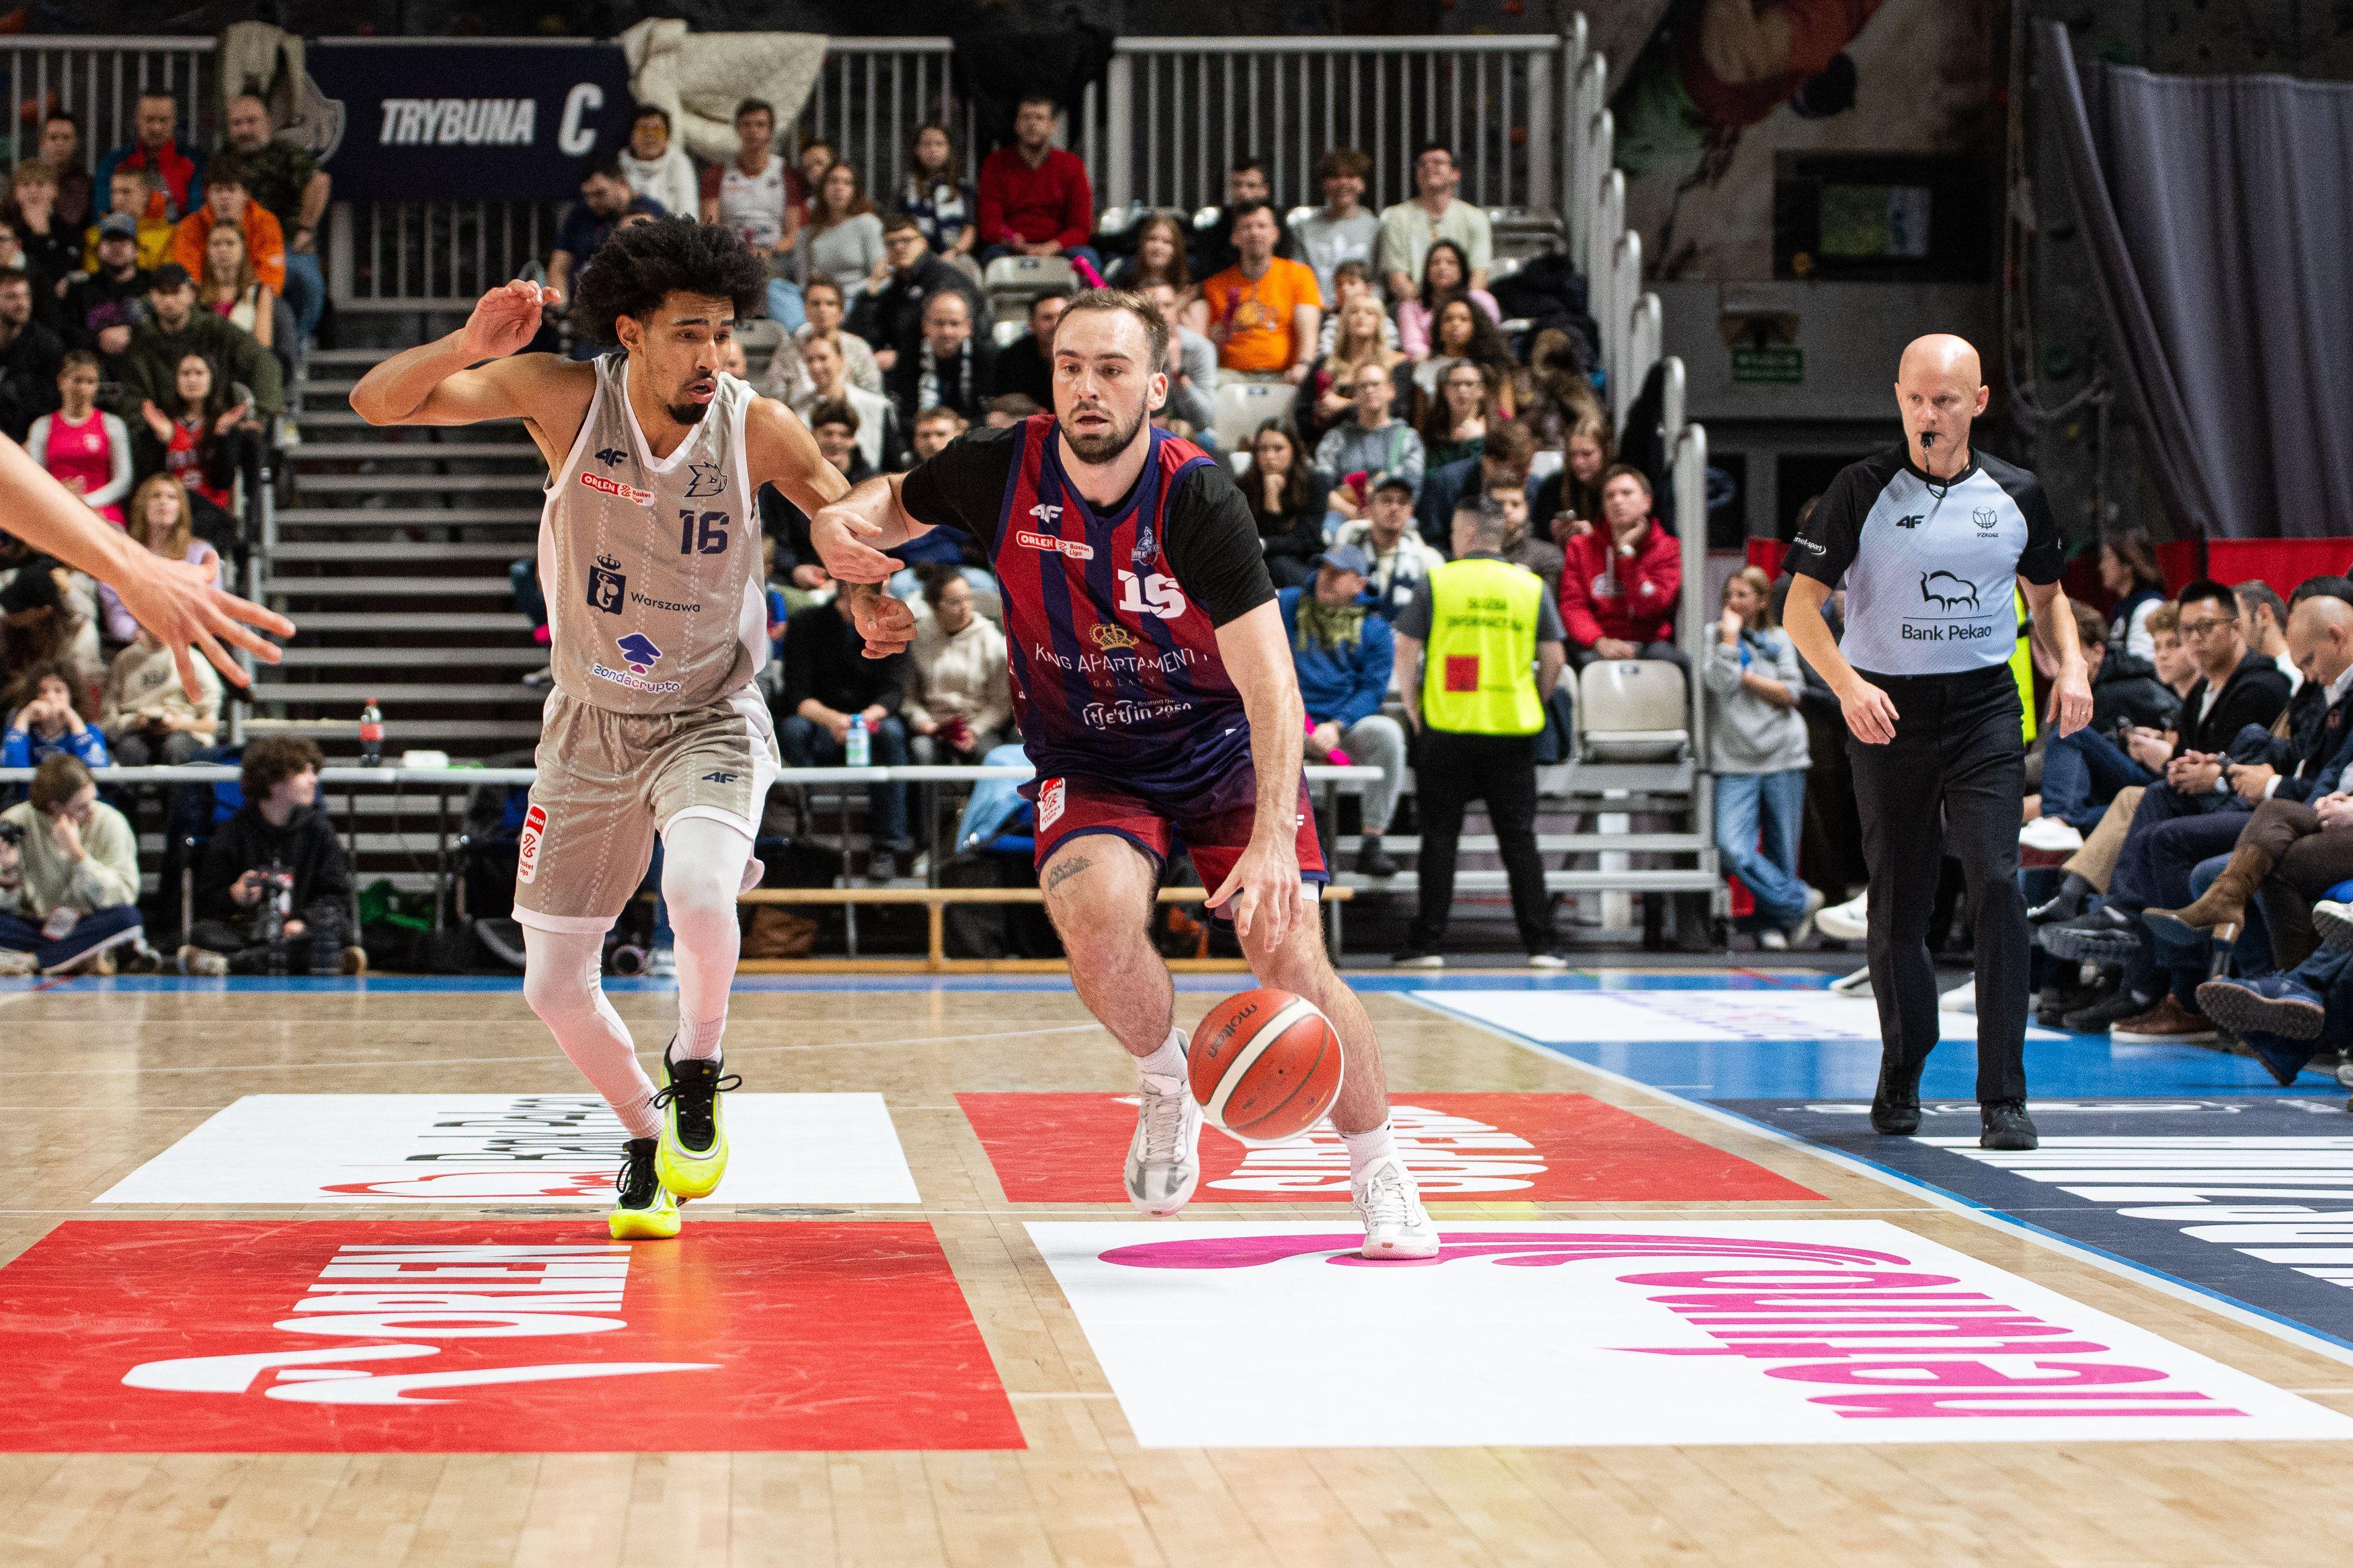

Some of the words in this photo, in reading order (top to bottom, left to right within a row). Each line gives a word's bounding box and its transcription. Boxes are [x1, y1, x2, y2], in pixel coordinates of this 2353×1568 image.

[381, 97, 537, 146] TRYBUNA
[559, 83, 604, 157] C
[594, 448, 629, 467] 4F
[584, 475, 615, 492] ORLEN
[633, 490, 651, 498] Basket
[1029, 503, 1063, 524] 4F
[1896, 514, 1925, 529] 4F
[679, 509, 729, 554] 16
[1021, 534, 1053, 548] ORLEN
[1070, 543, 1089, 552] Basket
[631, 591, 701, 612] Warszawa
[1117, 569, 1186, 618] 15
[1902, 624, 1944, 641] Bank
[1949, 624, 1992, 641] Pekao
[1078, 649, 1207, 672] APARTAMENT
[594, 664, 680, 692] zondacrypto
[702, 772, 738, 784] 4F
[528, 814, 545, 827] ORLEN
[1207, 1004, 1258, 1059] molten
[1111, 1097, 1548, 1193] SUPERB
[273, 1245, 631, 1337] ORLEN
[1597, 1270, 2253, 1418] netuno
